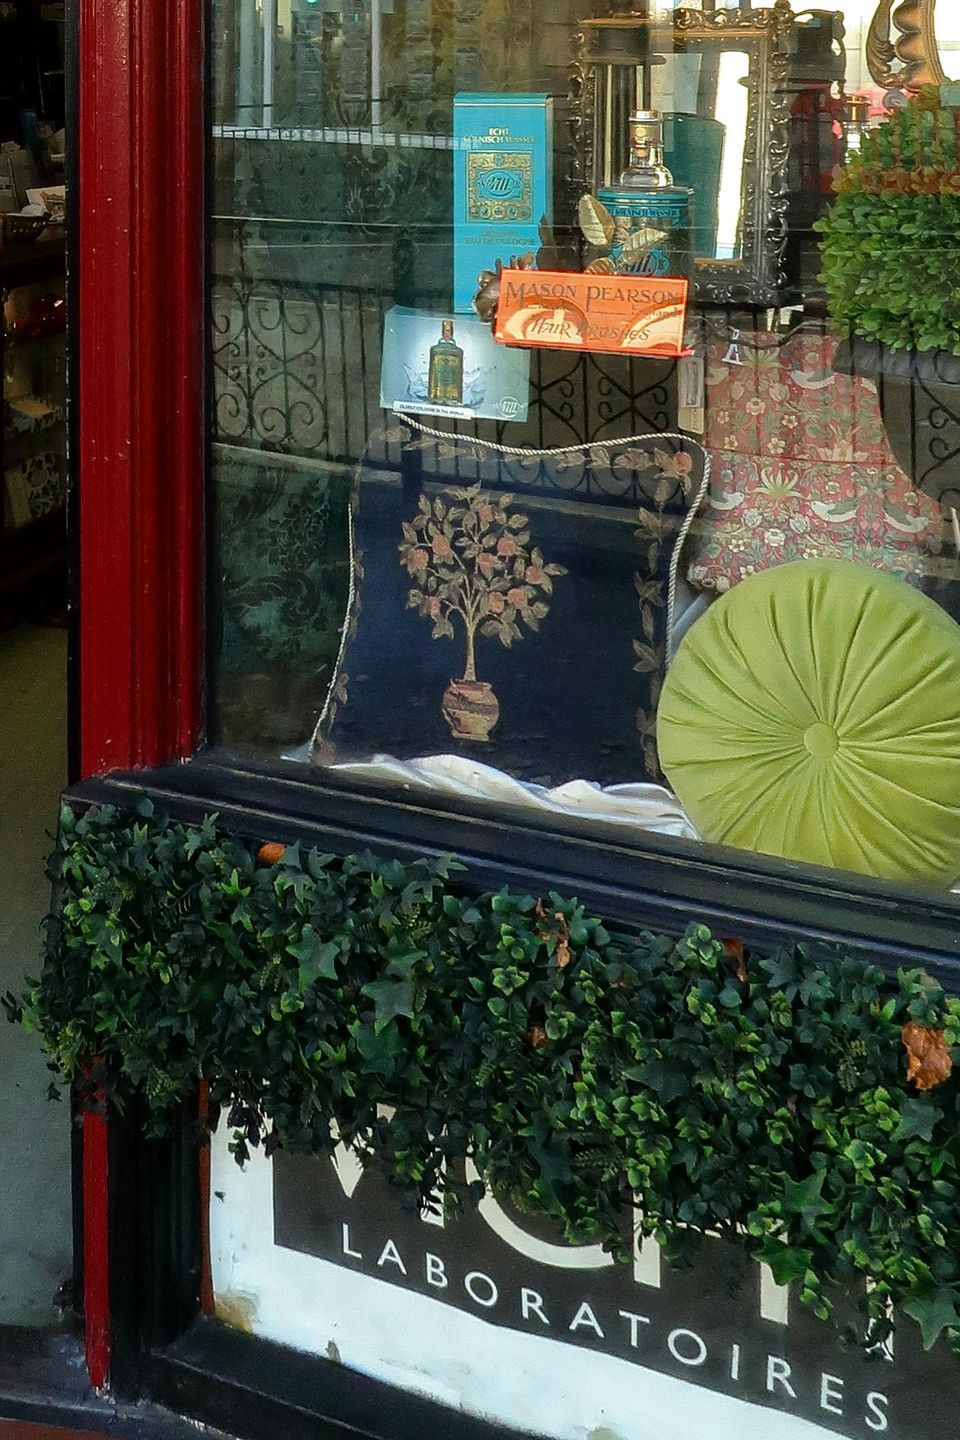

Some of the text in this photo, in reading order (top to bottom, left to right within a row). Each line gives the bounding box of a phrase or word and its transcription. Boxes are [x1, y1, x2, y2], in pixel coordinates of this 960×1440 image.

[505, 281, 679, 311] MASON PEARSON
[342, 1223, 890, 1432] LABORATOIRES
